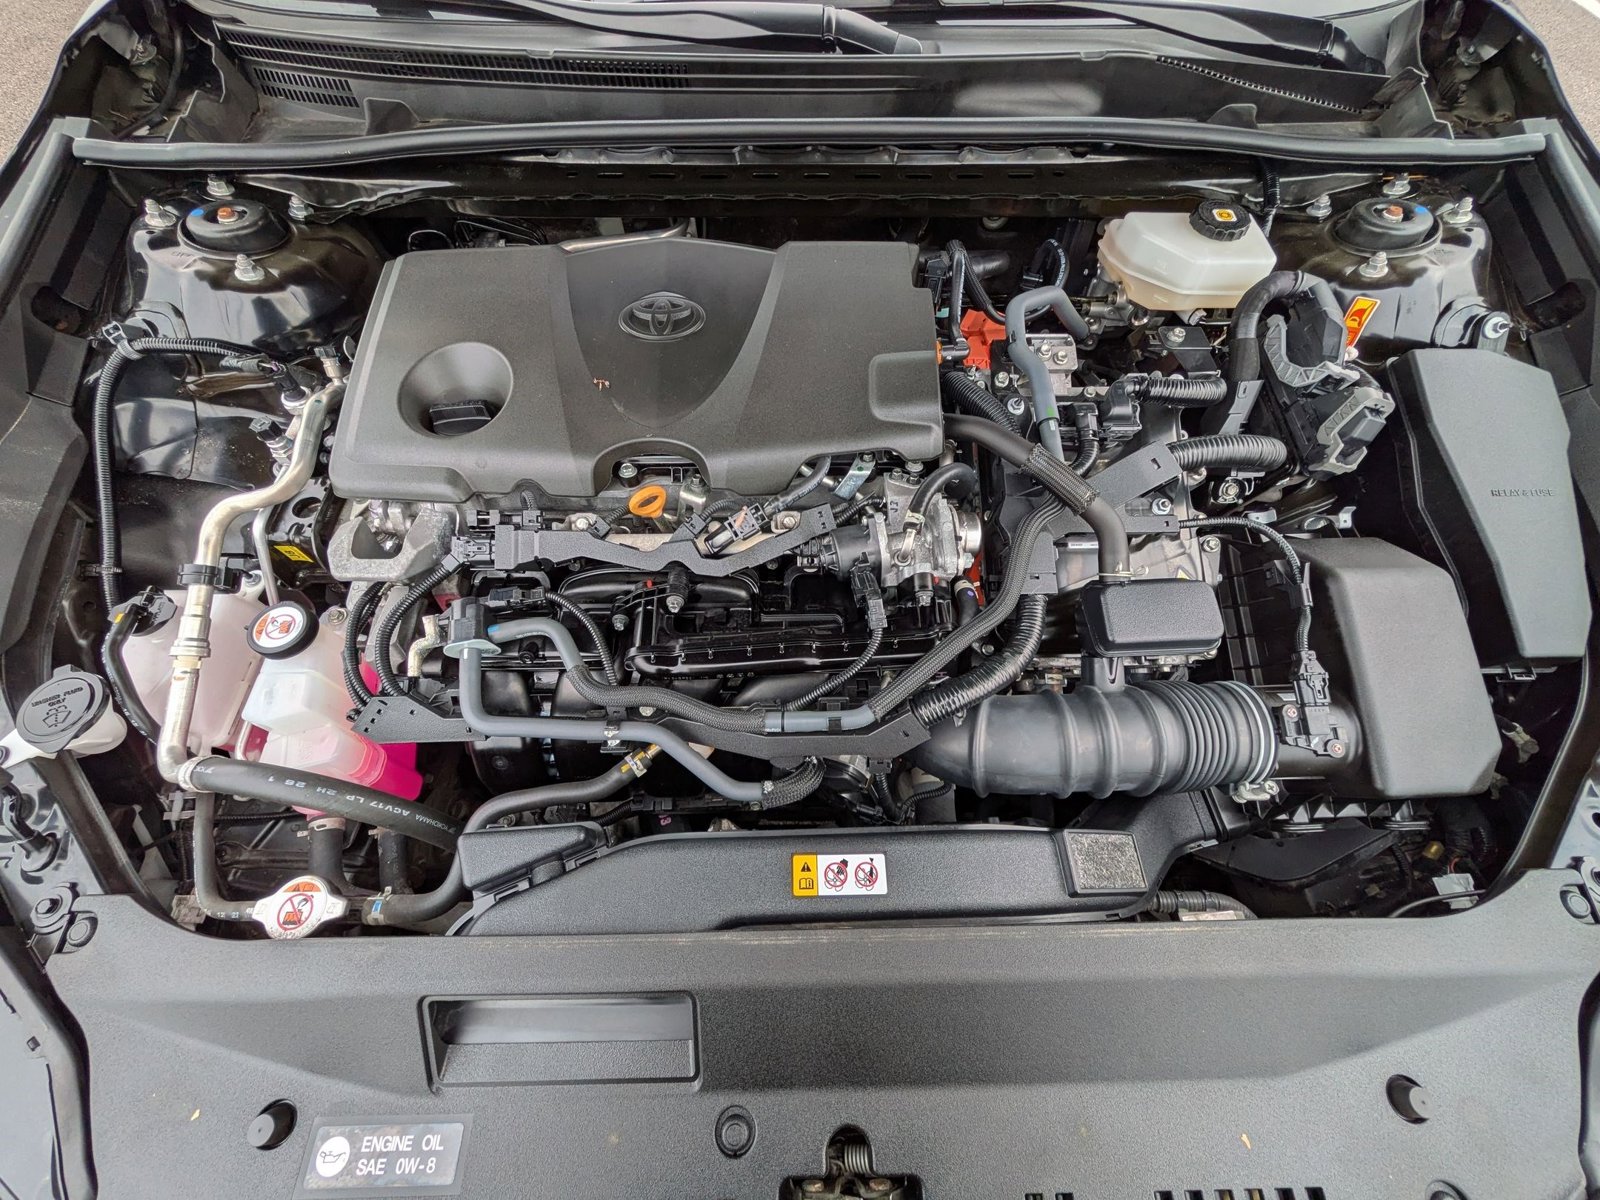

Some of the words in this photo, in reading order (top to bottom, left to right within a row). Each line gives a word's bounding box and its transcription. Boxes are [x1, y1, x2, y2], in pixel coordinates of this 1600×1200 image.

[1490, 488, 1520, 498] RELAY
[1521, 489, 1529, 497] &
[1530, 488, 1555, 498] FUSE
[345, 794, 365, 804] LP
[369, 800, 411, 817] ACV17
[415, 813, 449, 832] YOKOHAMA
[360, 1135, 415, 1153] ENGINE
[421, 1134, 444, 1151] OIL
[355, 1157, 388, 1176] SAE
[395, 1156, 437, 1175] 0W-8
